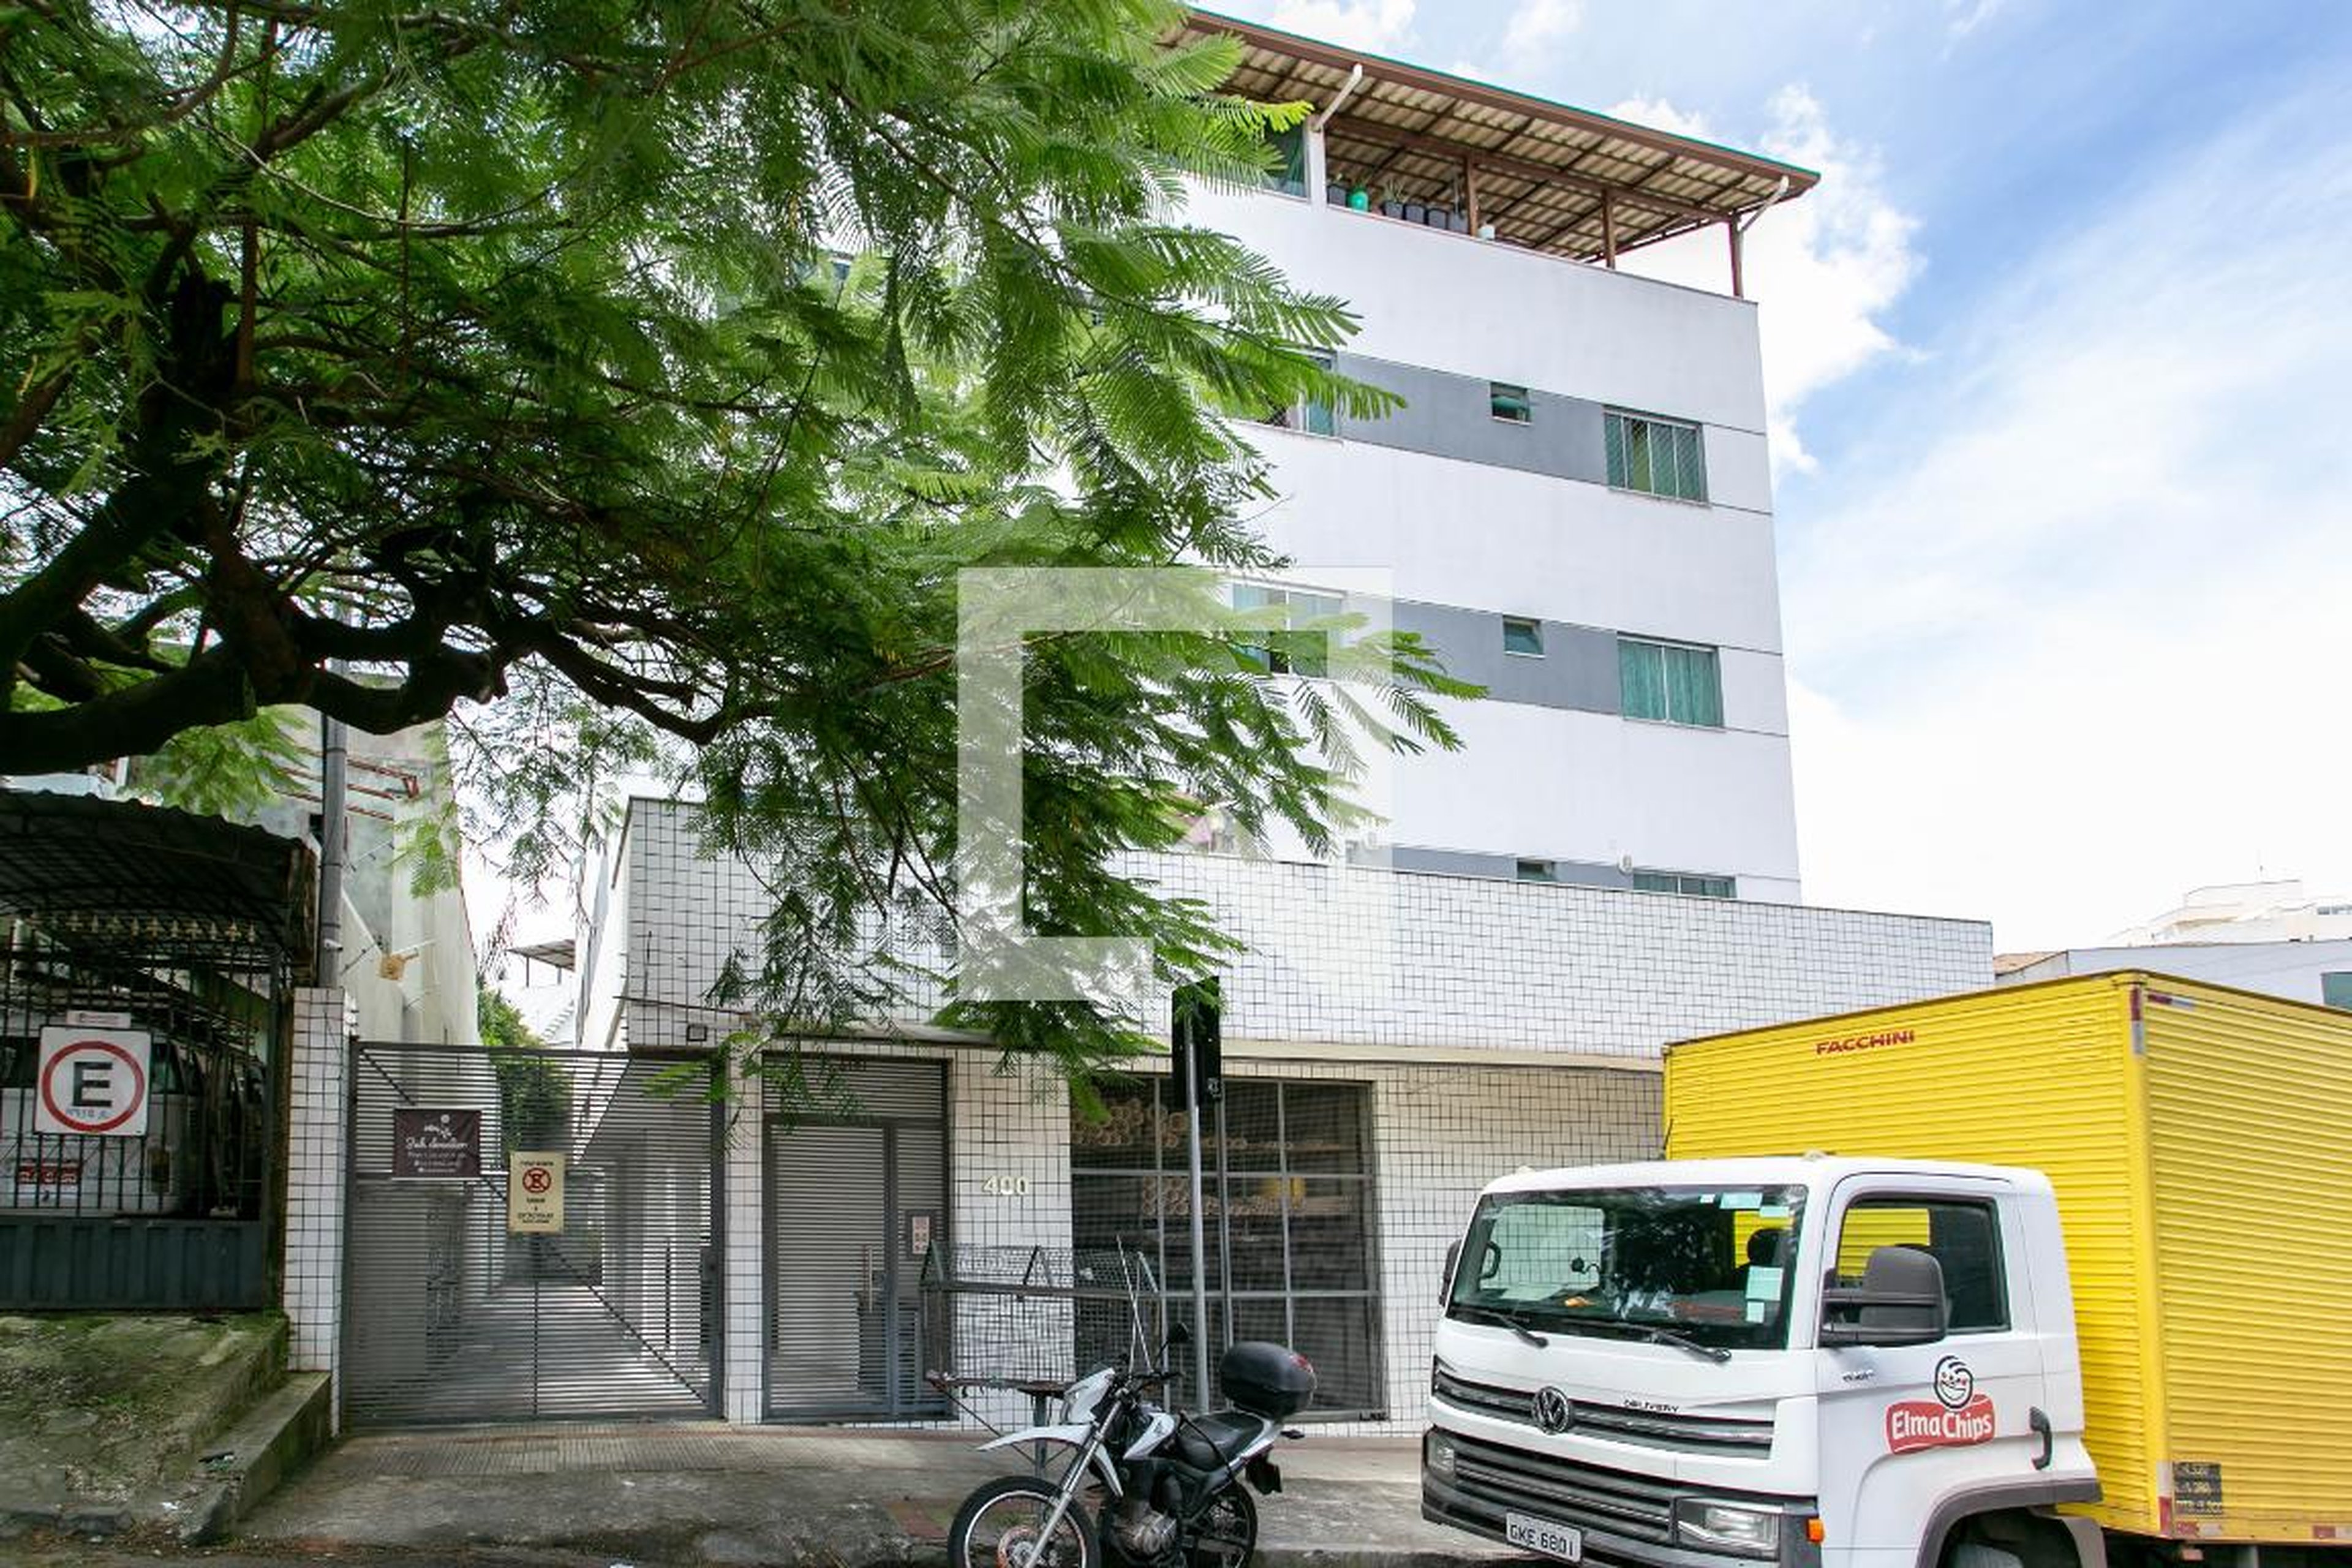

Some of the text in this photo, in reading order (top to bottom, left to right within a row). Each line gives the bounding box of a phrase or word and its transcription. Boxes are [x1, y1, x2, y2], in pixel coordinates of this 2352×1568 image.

[1817, 1030, 1915, 1055] FACCHINI
[73, 1061, 113, 1107] E
[982, 1176, 1028, 1194] 400
